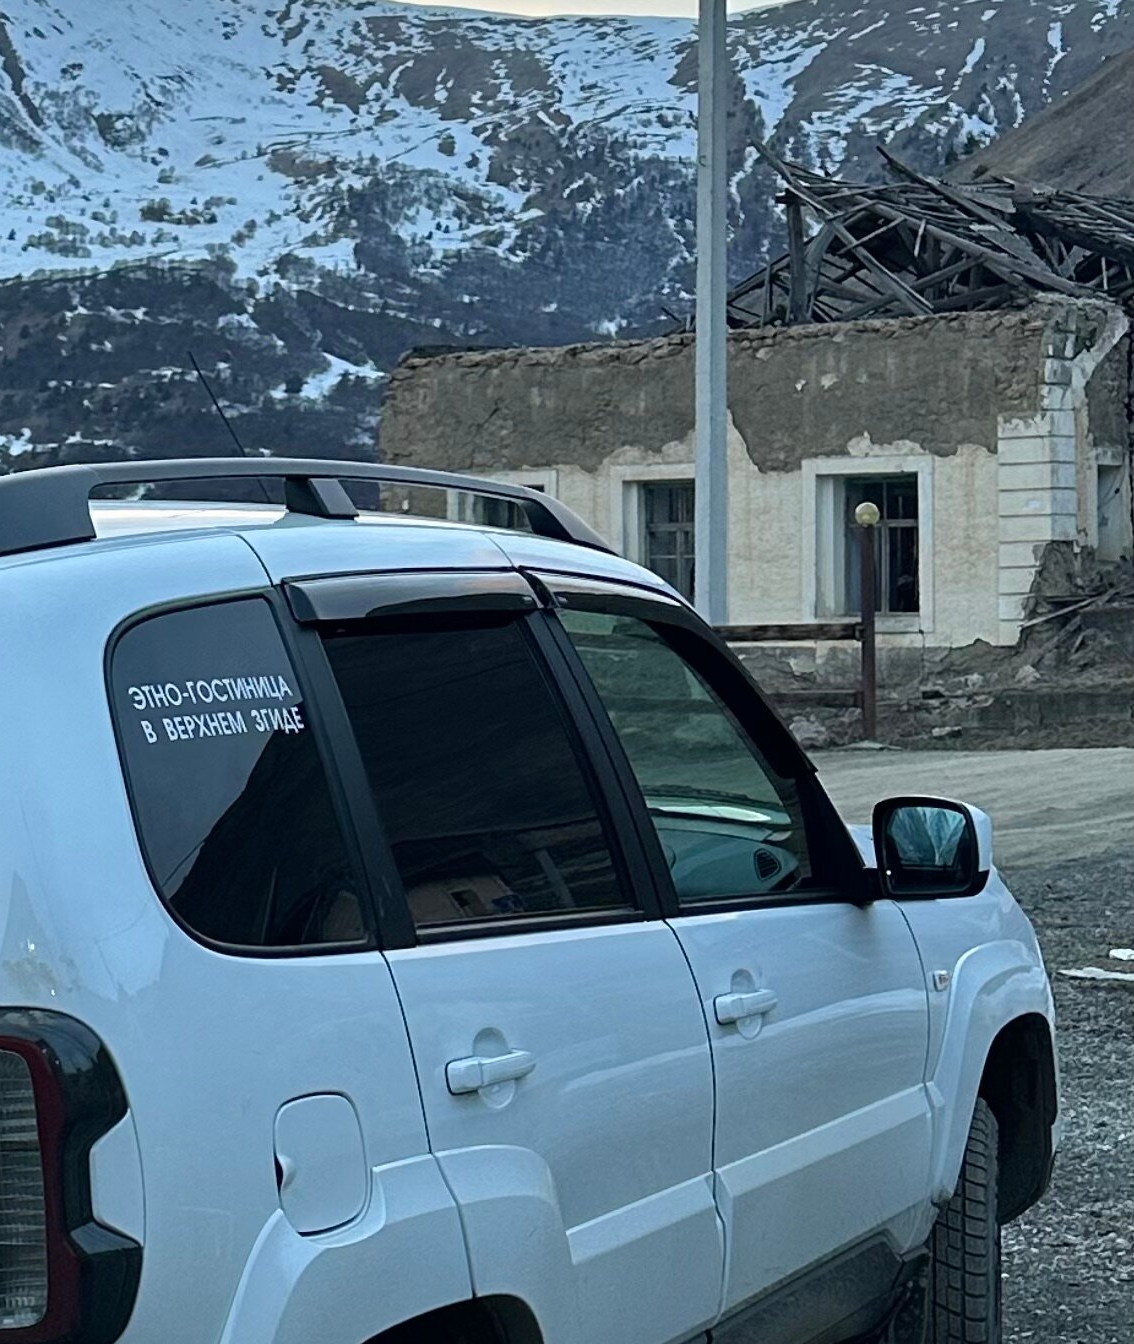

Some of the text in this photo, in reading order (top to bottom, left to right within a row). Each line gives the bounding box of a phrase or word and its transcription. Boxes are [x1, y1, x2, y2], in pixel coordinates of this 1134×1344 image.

[128, 675, 293, 711] ЭТНО-ГОСТИНИЦА
[140, 706, 305, 744] В ВЕРХНЕМ ЗГИДЕ
